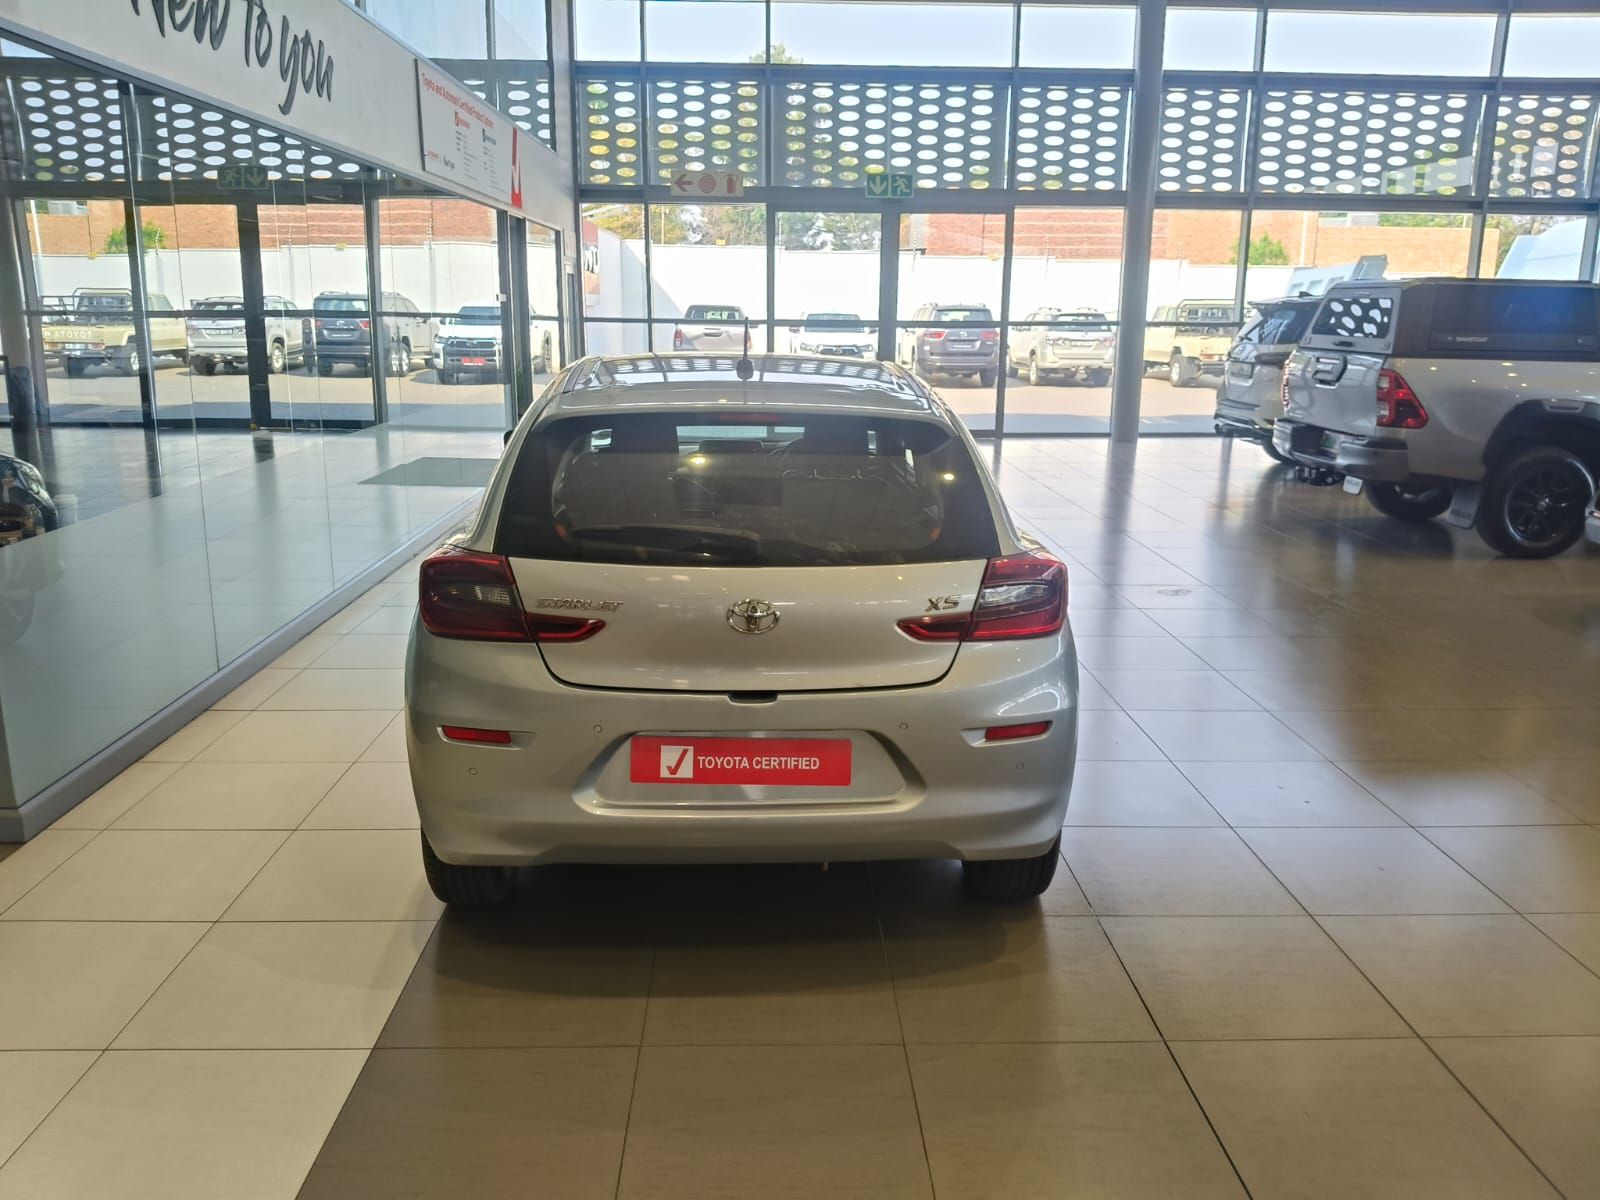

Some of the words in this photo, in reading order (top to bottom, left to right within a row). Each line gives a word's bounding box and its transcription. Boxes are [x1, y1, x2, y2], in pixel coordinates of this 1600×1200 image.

[278, 15, 334, 115] you
[536, 598, 624, 612] STARLET
[925, 594, 960, 612] XS
[697, 756, 750, 769] TOYOTA
[752, 756, 820, 770] CERTIFIED
